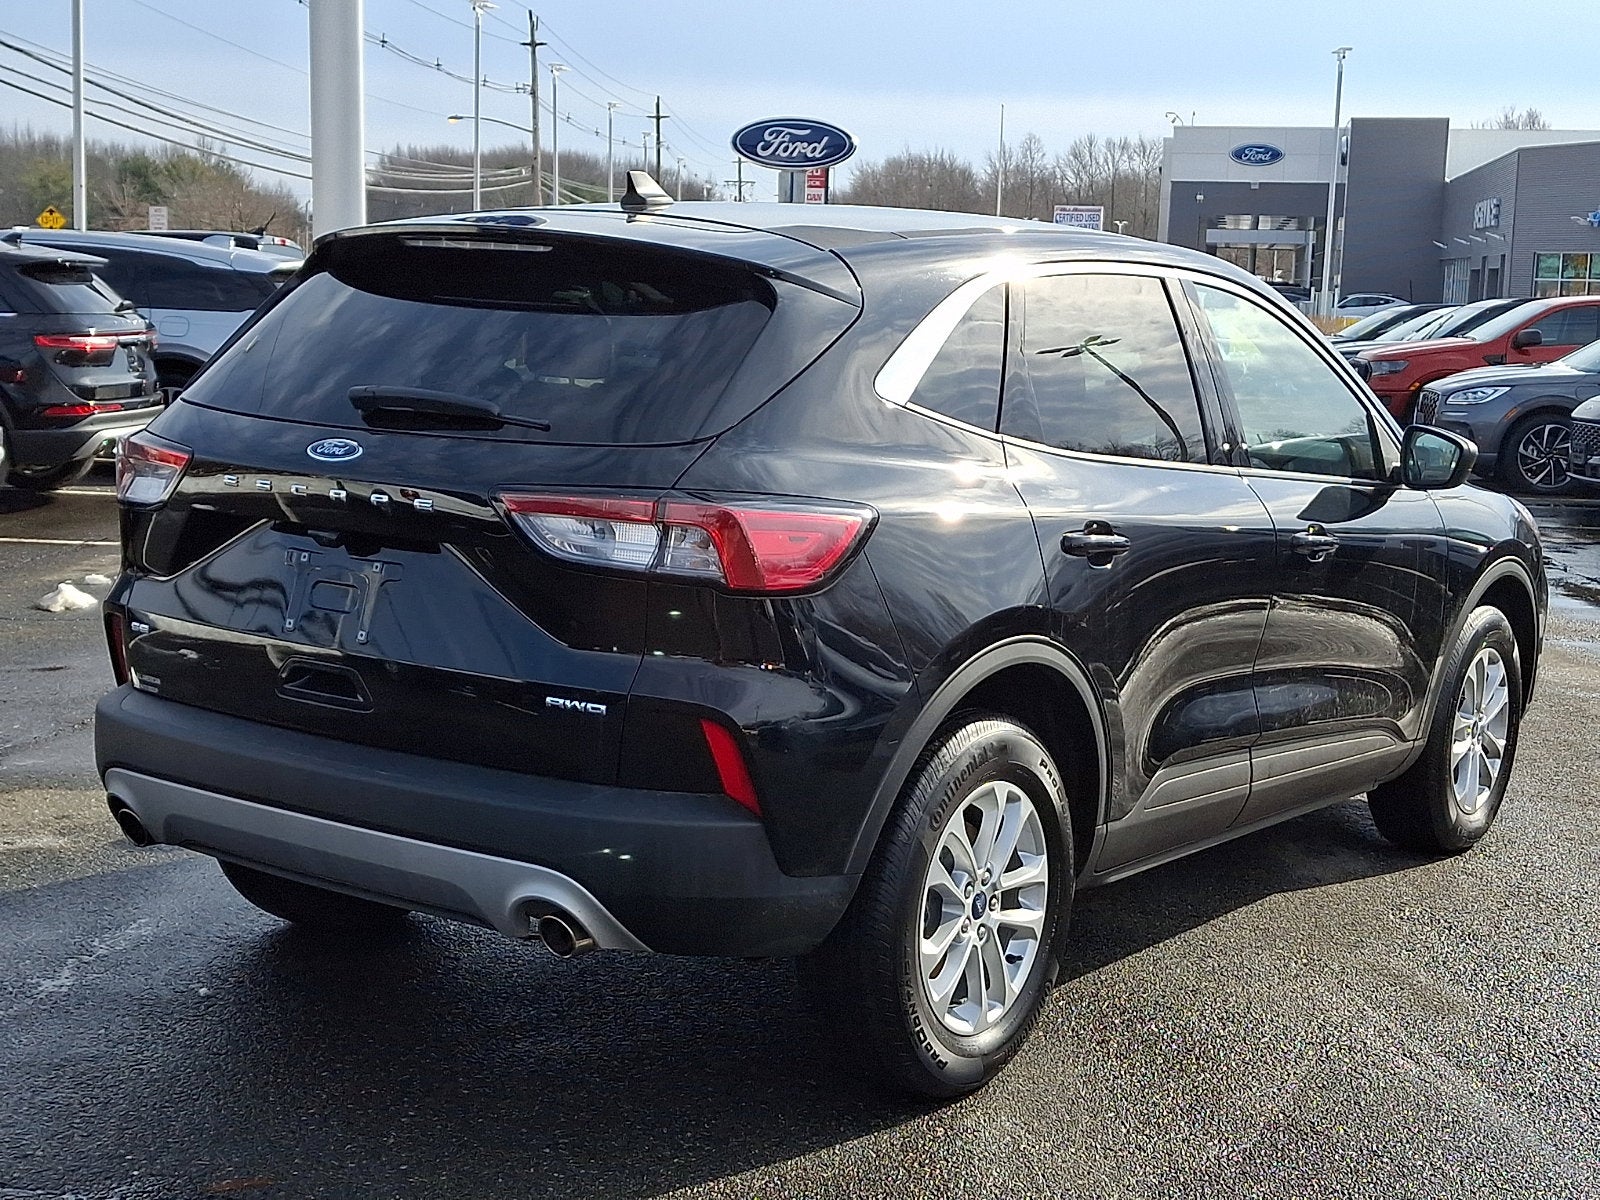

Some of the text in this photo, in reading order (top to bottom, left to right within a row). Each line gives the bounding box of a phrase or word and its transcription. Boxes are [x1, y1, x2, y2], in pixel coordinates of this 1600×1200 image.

[757, 126, 829, 158] Ford
[1241, 147, 1273, 161] Ford
[1055, 213, 1101, 223] CERTIFIED USED
[316, 440, 350, 455] Ford
[223, 474, 434, 513] ESCAPE
[545, 696, 607, 715] AWD
[929, 744, 992, 833] Continental
